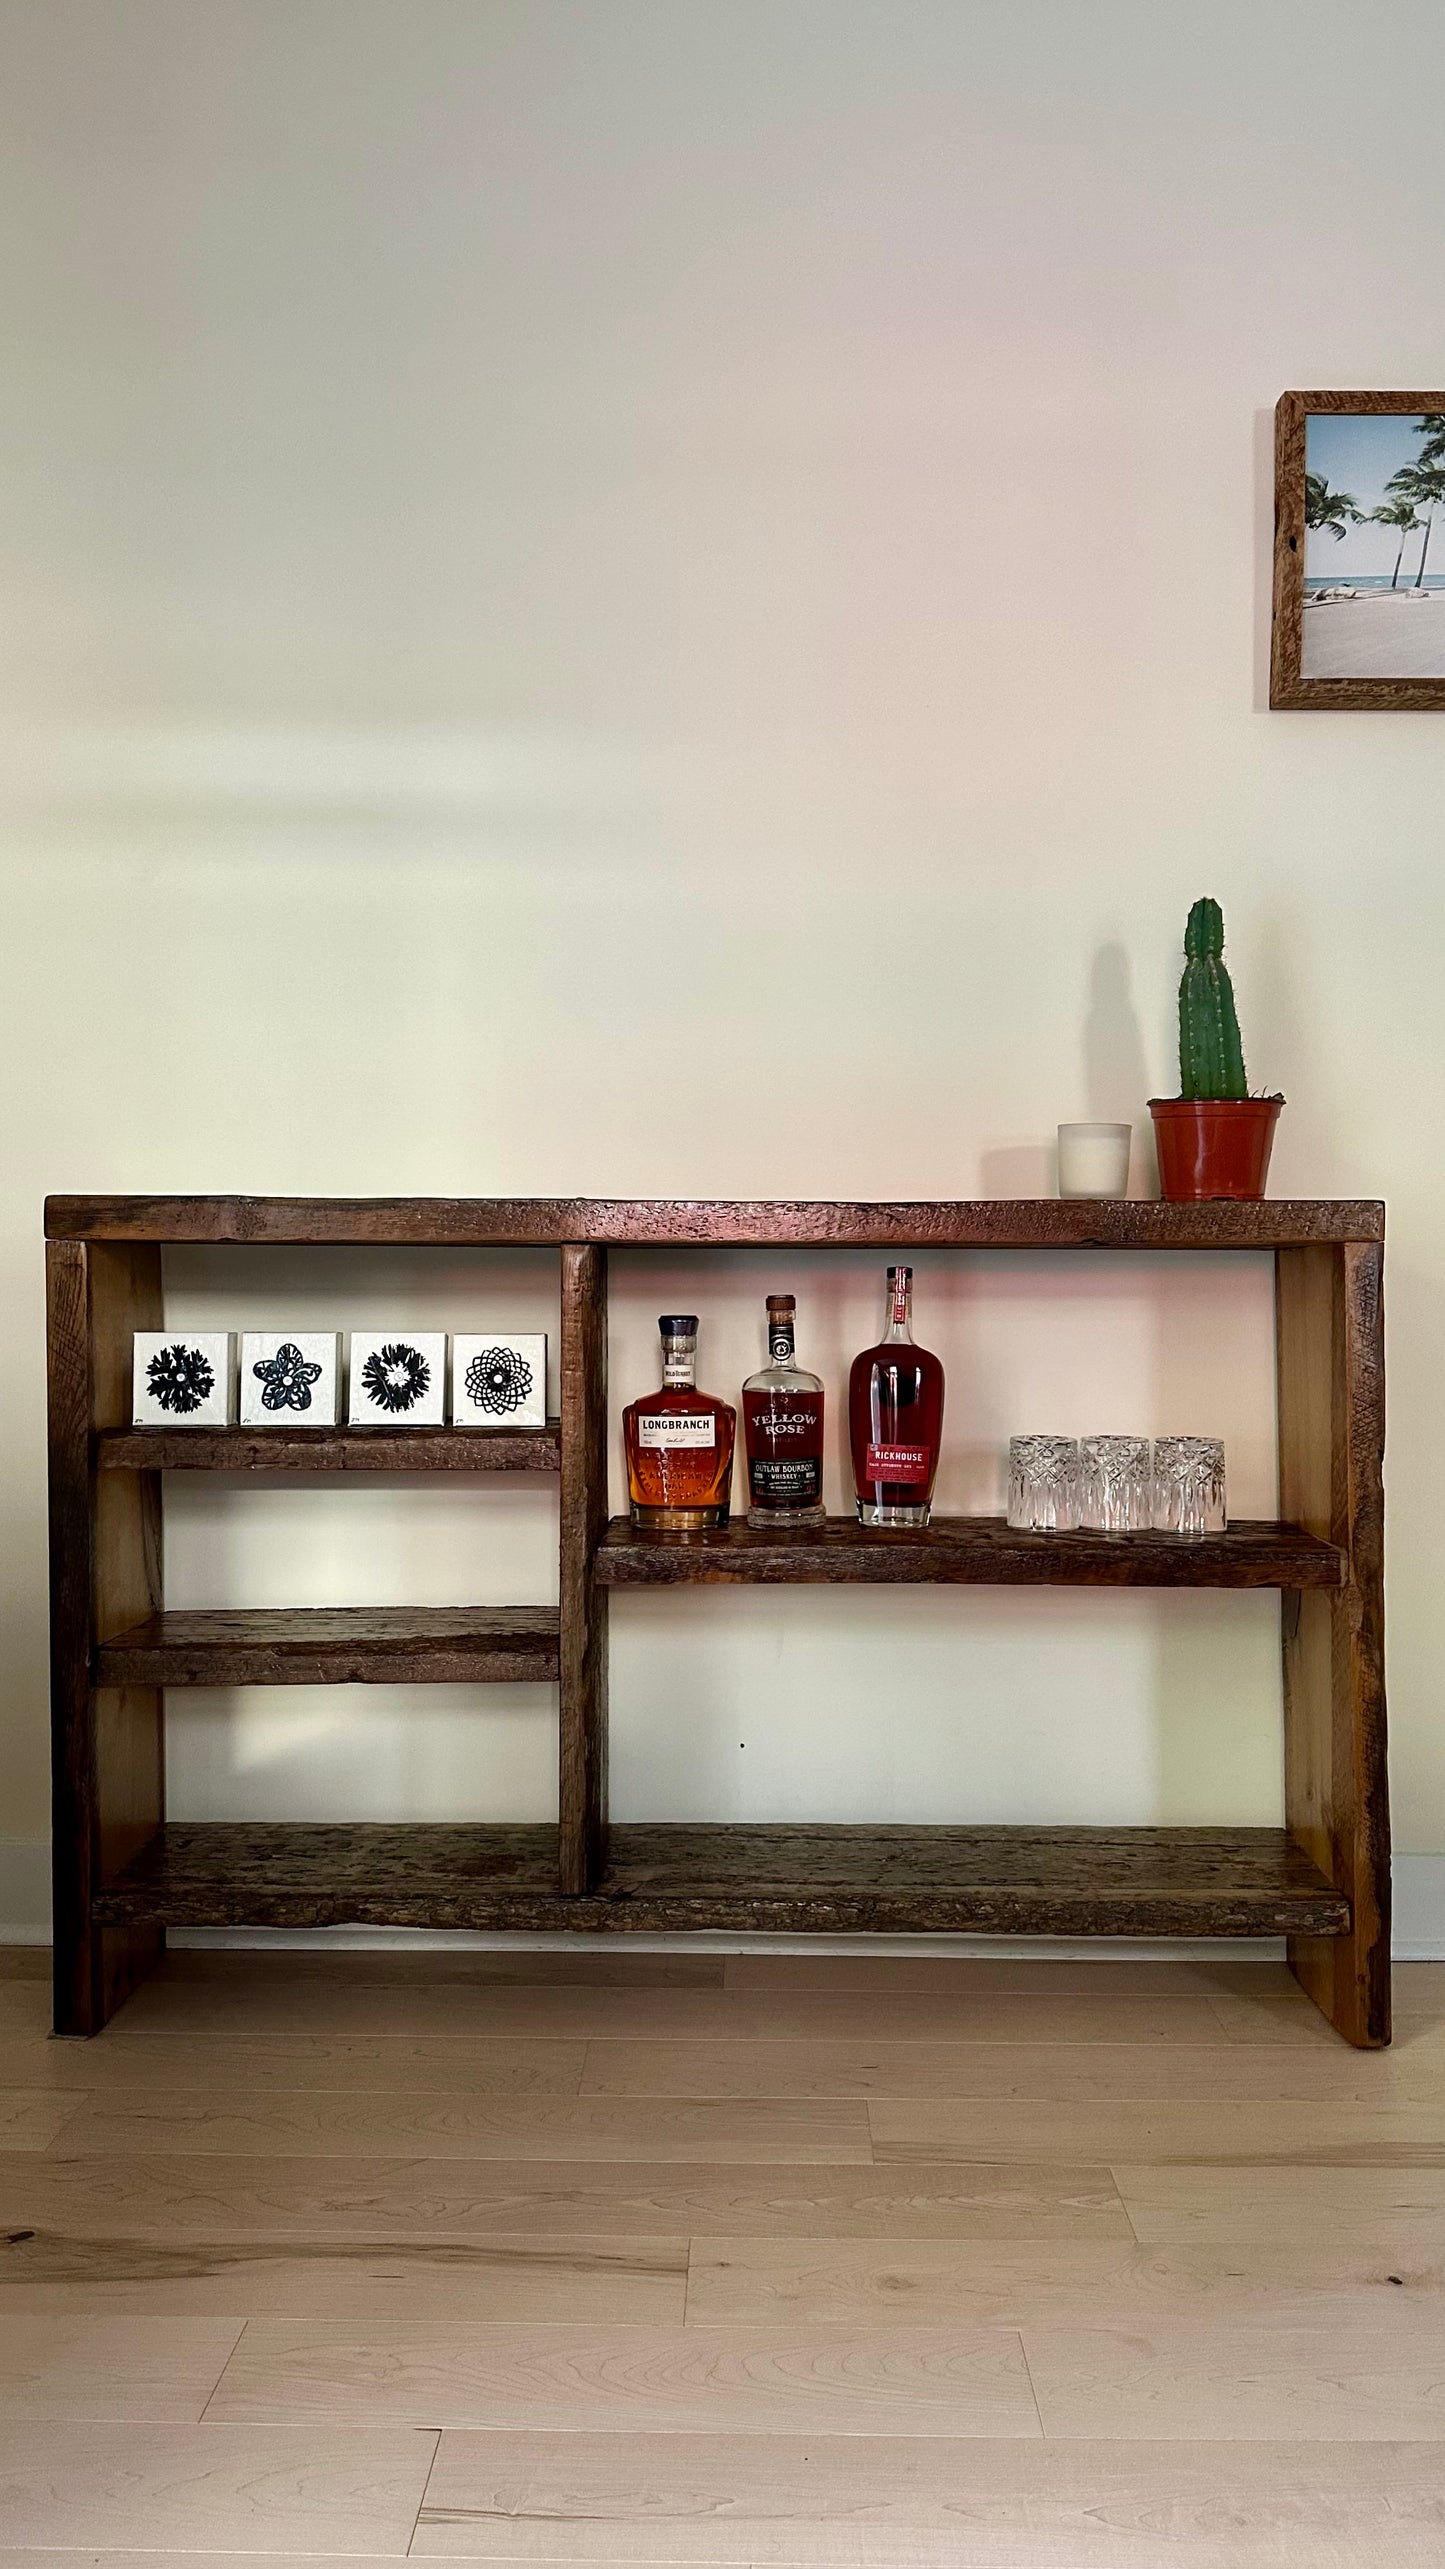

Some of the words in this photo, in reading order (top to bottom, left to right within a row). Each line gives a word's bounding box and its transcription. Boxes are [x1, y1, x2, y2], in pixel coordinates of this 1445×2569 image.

[643, 1420, 709, 1430] LONGBRANCH
[752, 1414, 817, 1426] YELLOW
[765, 1424, 805, 1435] ROSE
[875, 1451, 923, 1462] RICKHOUSE
[755, 1464, 780, 1473] OUTLAW
[782, 1464, 813, 1473] BOURBON
